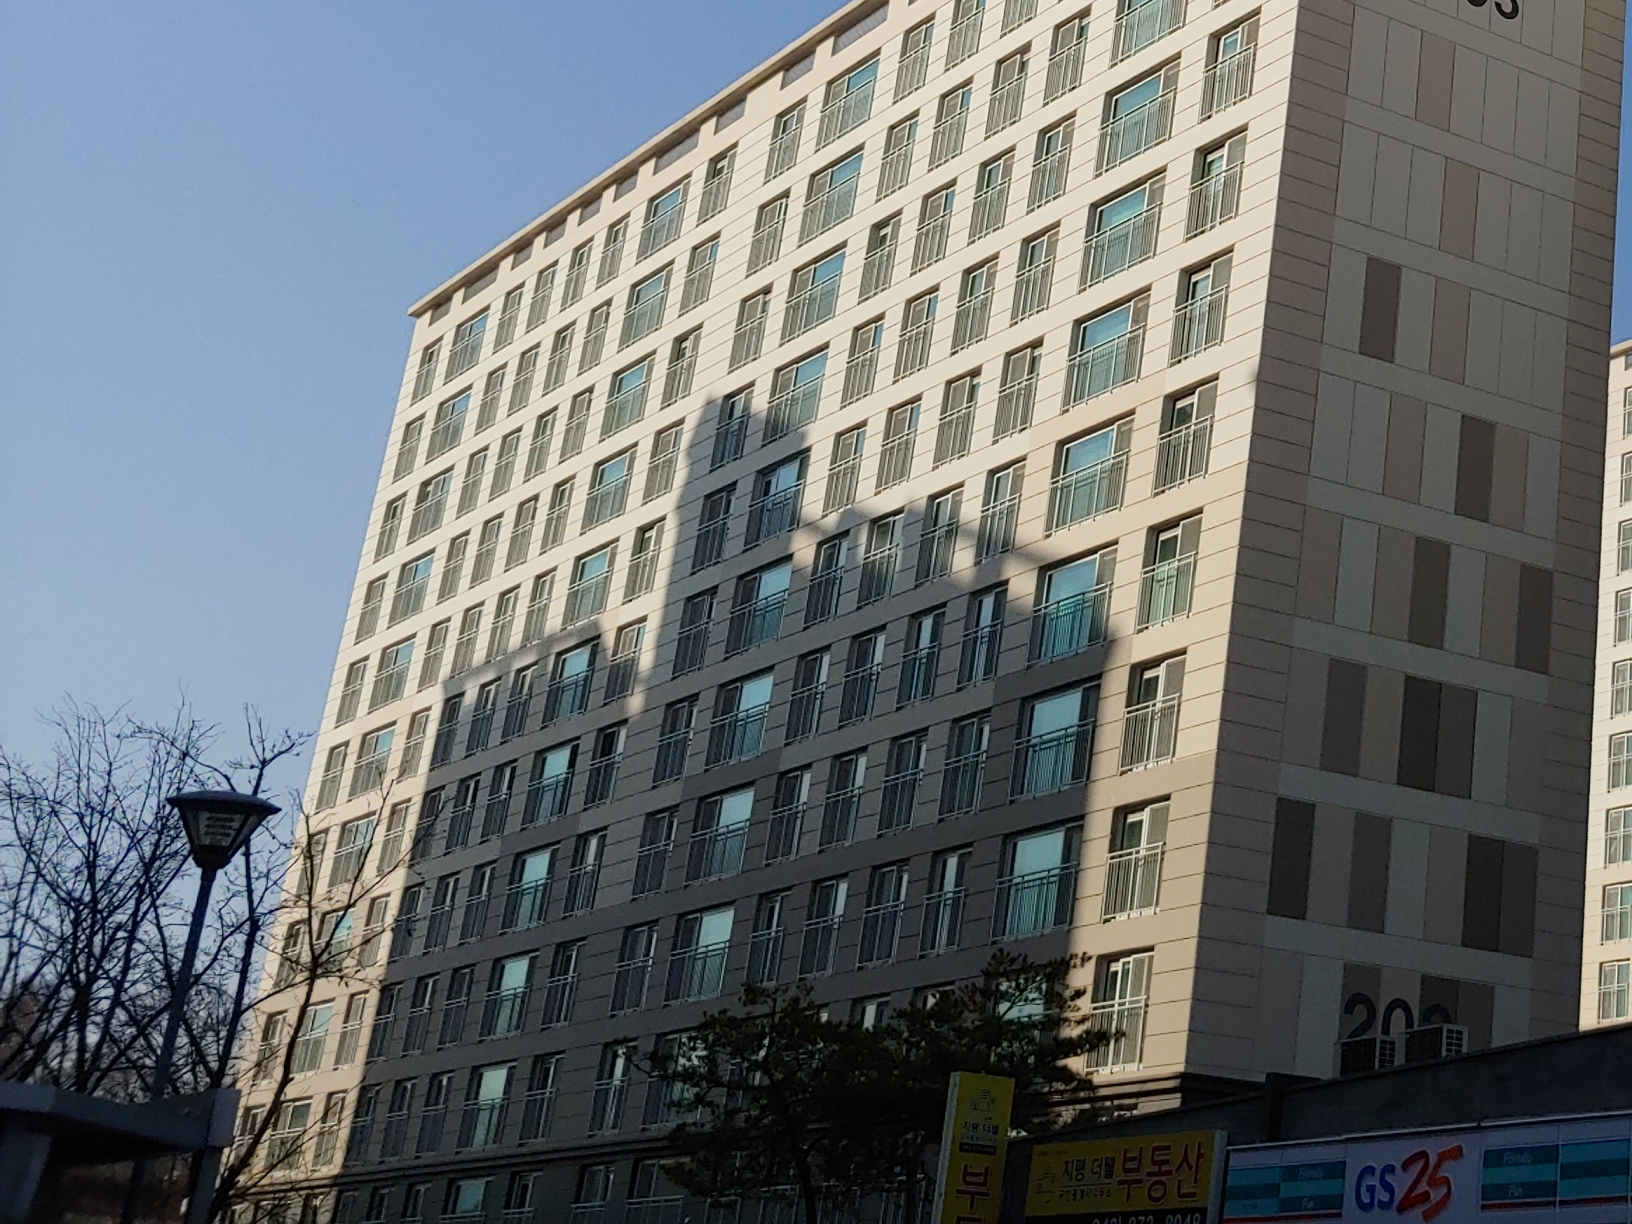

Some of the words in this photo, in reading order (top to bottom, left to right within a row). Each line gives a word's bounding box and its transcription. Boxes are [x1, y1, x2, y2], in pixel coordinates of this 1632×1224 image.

[1061, 1157, 1087, 1183] 지평
[1090, 1155, 1116, 1180] 더웰
[1115, 1140, 1205, 1205] 부동산
